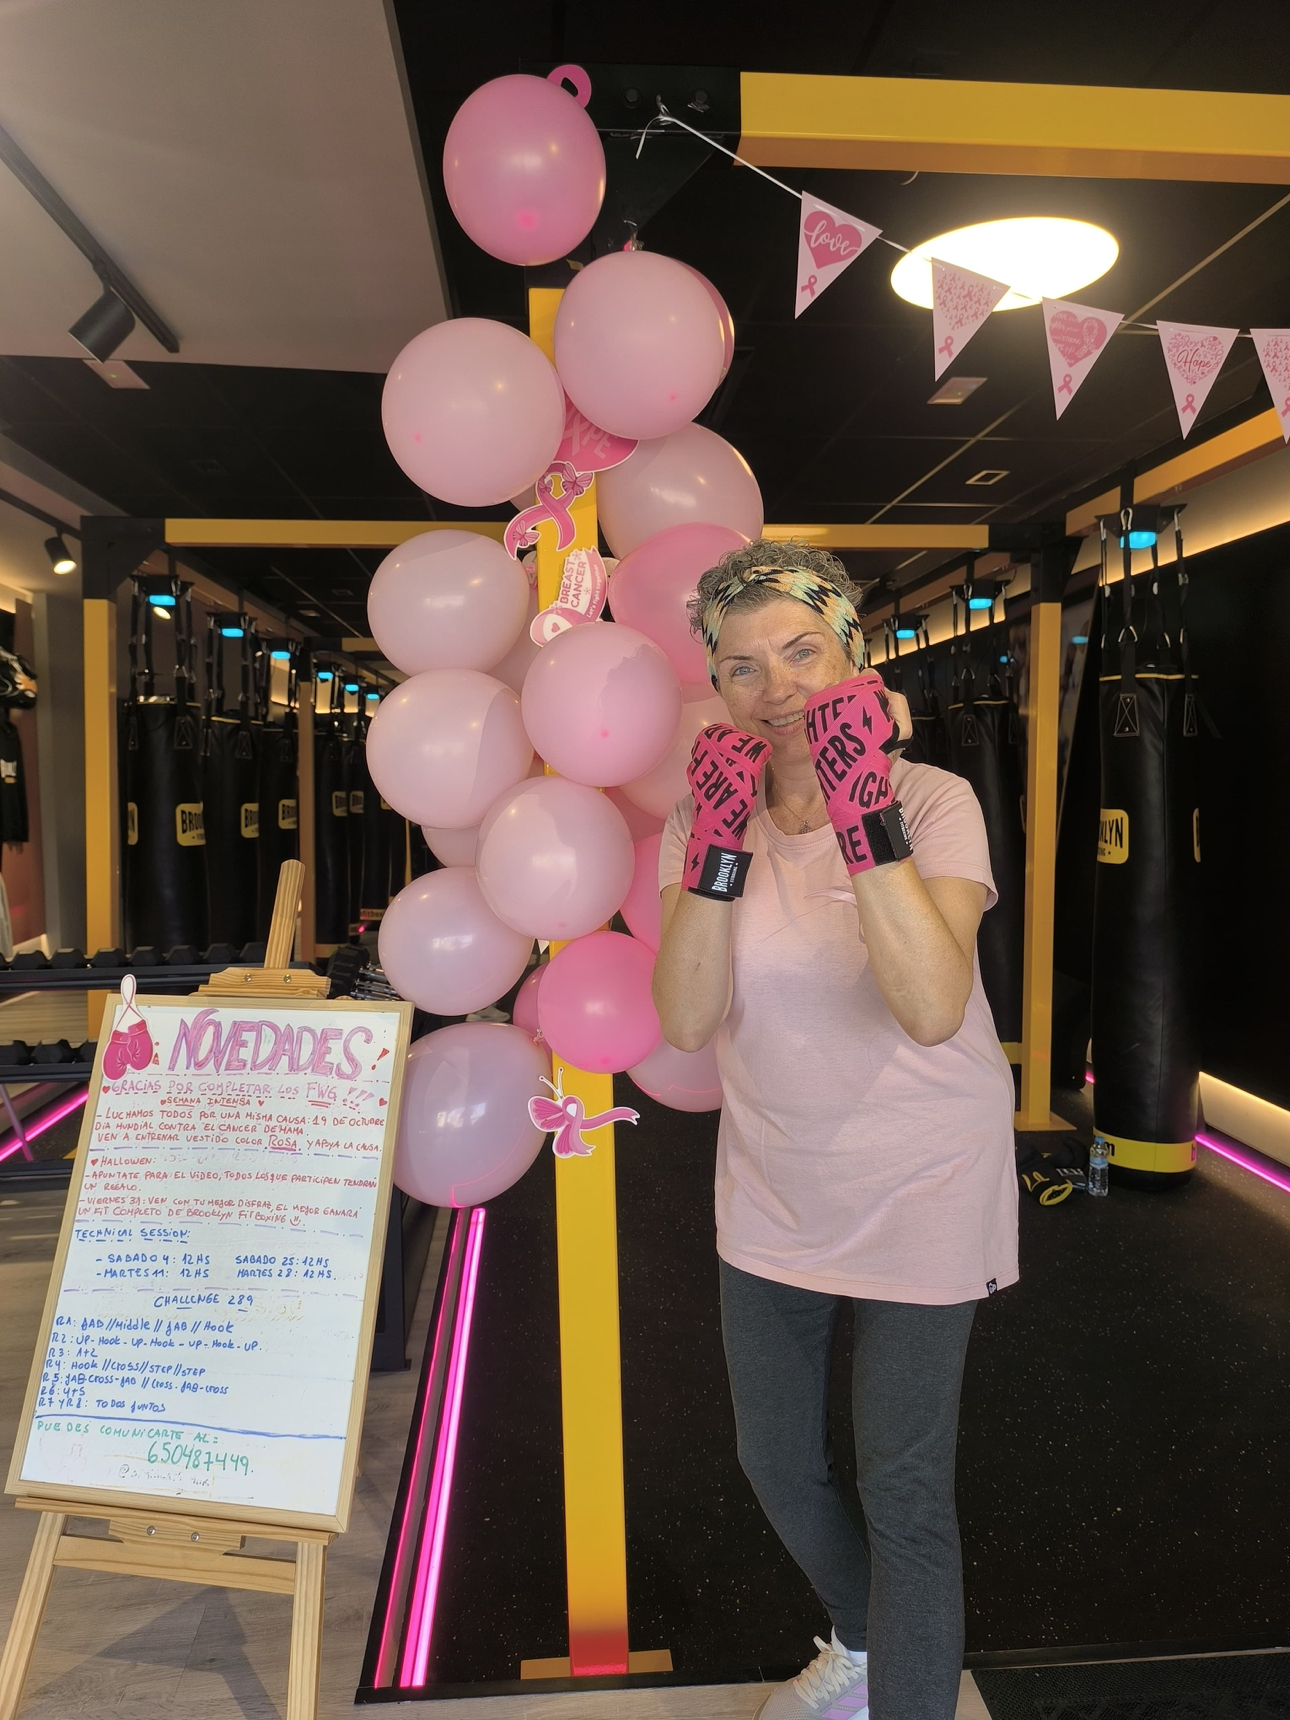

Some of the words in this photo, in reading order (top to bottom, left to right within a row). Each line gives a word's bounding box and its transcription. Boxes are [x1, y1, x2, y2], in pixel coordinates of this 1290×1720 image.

[804, 220, 860, 256] love
[1176, 347, 1212, 373] Hope
[560, 558, 576, 604] BREAST
[570, 561, 587, 608] CANCER
[696, 760, 739, 810] ARE
[722, 799, 754, 841] WE
[836, 825, 867, 866] RE
[711, 852, 738, 892] BROOKLYN
[168, 1081, 194, 1095] POR
[198, 1081, 271, 1096] COMPLETAR
[278, 1083, 300, 1096] LOS
[167, 1096, 201, 1104] SEMANA
[207, 1097, 251, 1106] INTENSA
[105, 1106, 154, 1119] LUCHAMOS
[160, 1110, 193, 1119] TODOS
[200, 1111, 217, 1120] POR
[221, 1111, 241, 1120] UNA
[312, 1115, 327, 1126] 19
[333, 1118, 345, 1126] DE
[348, 1117, 385, 1127] OCTUBRE
[158, 1123, 197, 1131] CONTRA
[203, 1123, 215, 1131] EL
[218, 1123, 257, 1132] CANCER
[97, 1132, 118, 1142] VEN
[122, 1133, 133, 1141] A
[135, 1132, 180, 1141] ENTRENAR
[235, 1136, 263, 1145] COLOR
[144, 1171, 169, 1181] PARA
[173, 1171, 186, 1179] EL
[224, 1171, 252, 1181] TODOS
[84, 1182, 98, 1190] UN
[78, 1206, 91, 1216] UN
[112, 1206, 163, 1218] COMPLETO
[167, 1208, 182, 1216] DE
[148, 1196, 168, 1205] VEN
[207, 1199, 235, 1208] MEJOR
[275, 1203, 289, 1212] EL
[292, 1204, 320, 1216] MEJOR
[107, 1252, 158, 1263] SABADO
[235, 1254, 277, 1265] SABADO
[237, 1269, 273, 1278] MARTES
[153, 1293, 220, 1308] CHALLENGE
[227, 1295, 254, 1306] 289
[96, 1399, 126, 1408] TODOS
